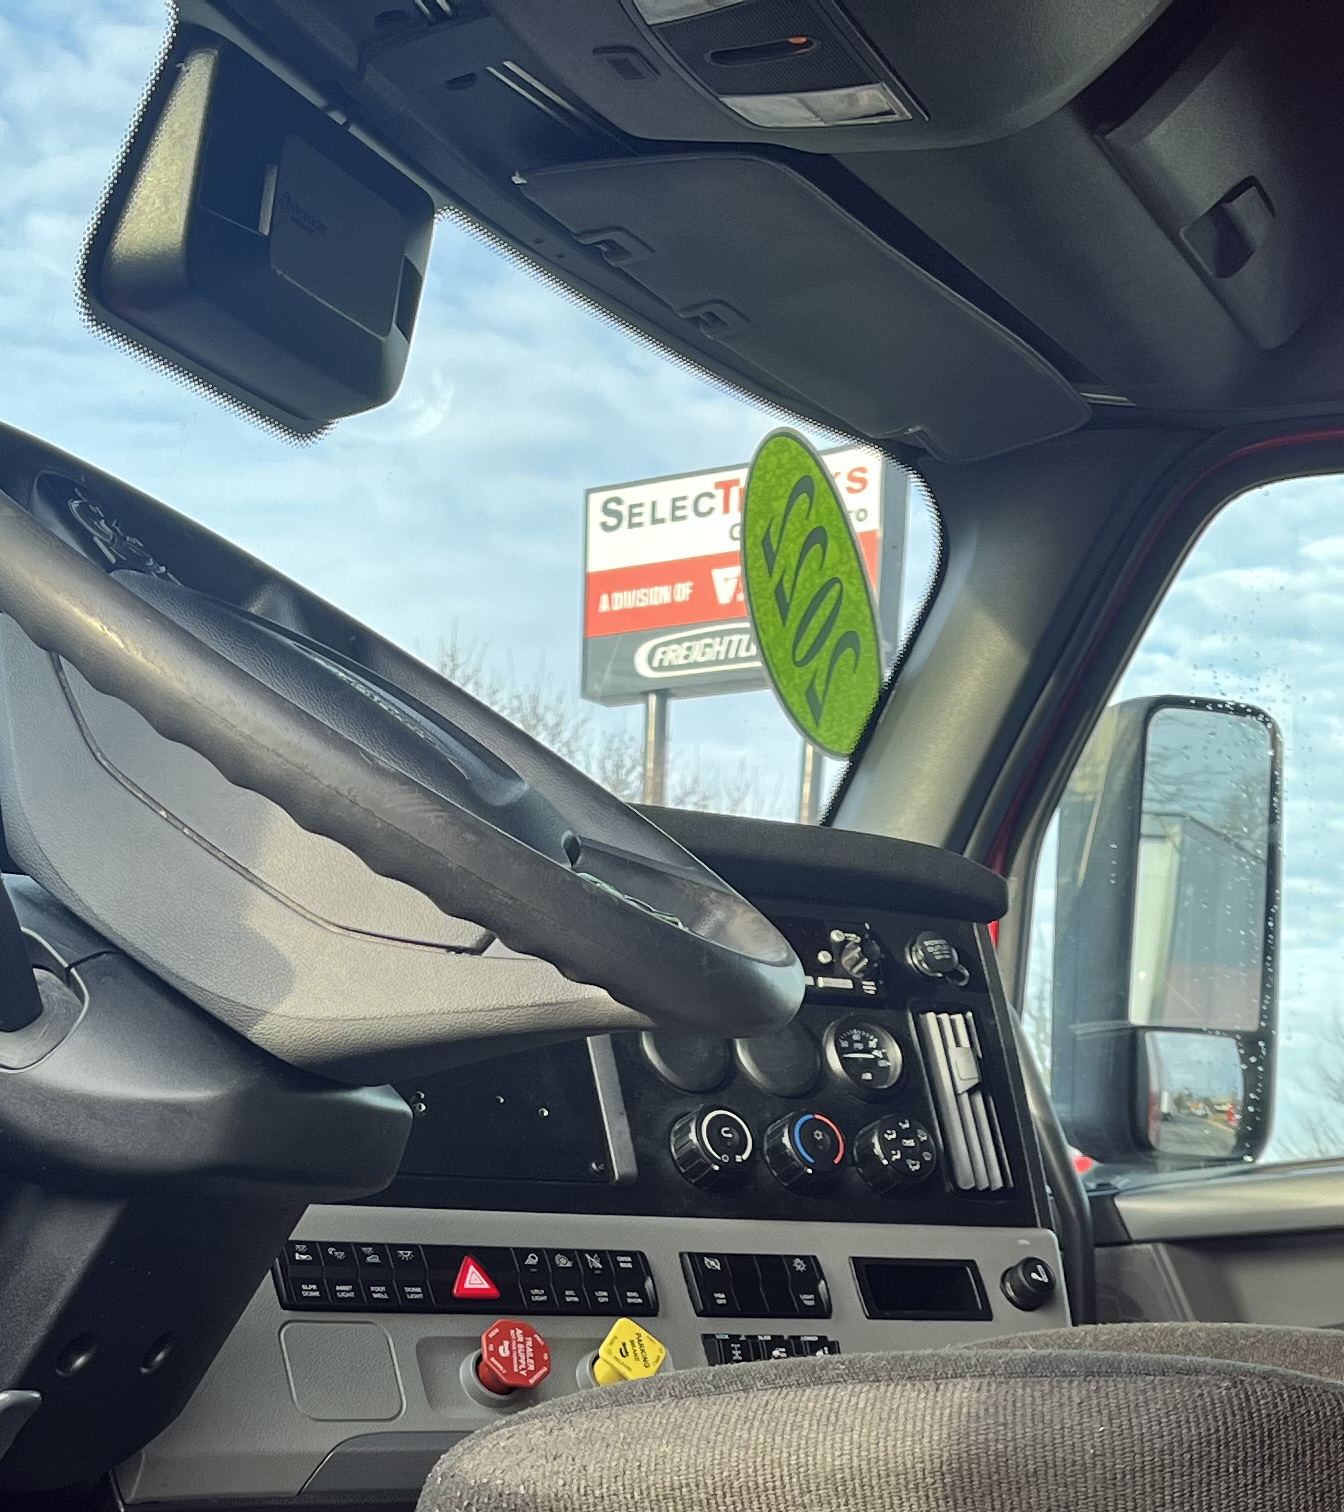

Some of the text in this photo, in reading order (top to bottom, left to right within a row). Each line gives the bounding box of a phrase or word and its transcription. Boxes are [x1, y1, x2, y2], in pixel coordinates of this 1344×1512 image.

[598, 593, 610, 613] A
[611, 585, 672, 611] DIVISION
[673, 582, 694, 602] OF
[652, 634, 756, 668] FREIGHTL
[635, 1332, 651, 1369] PARKING
